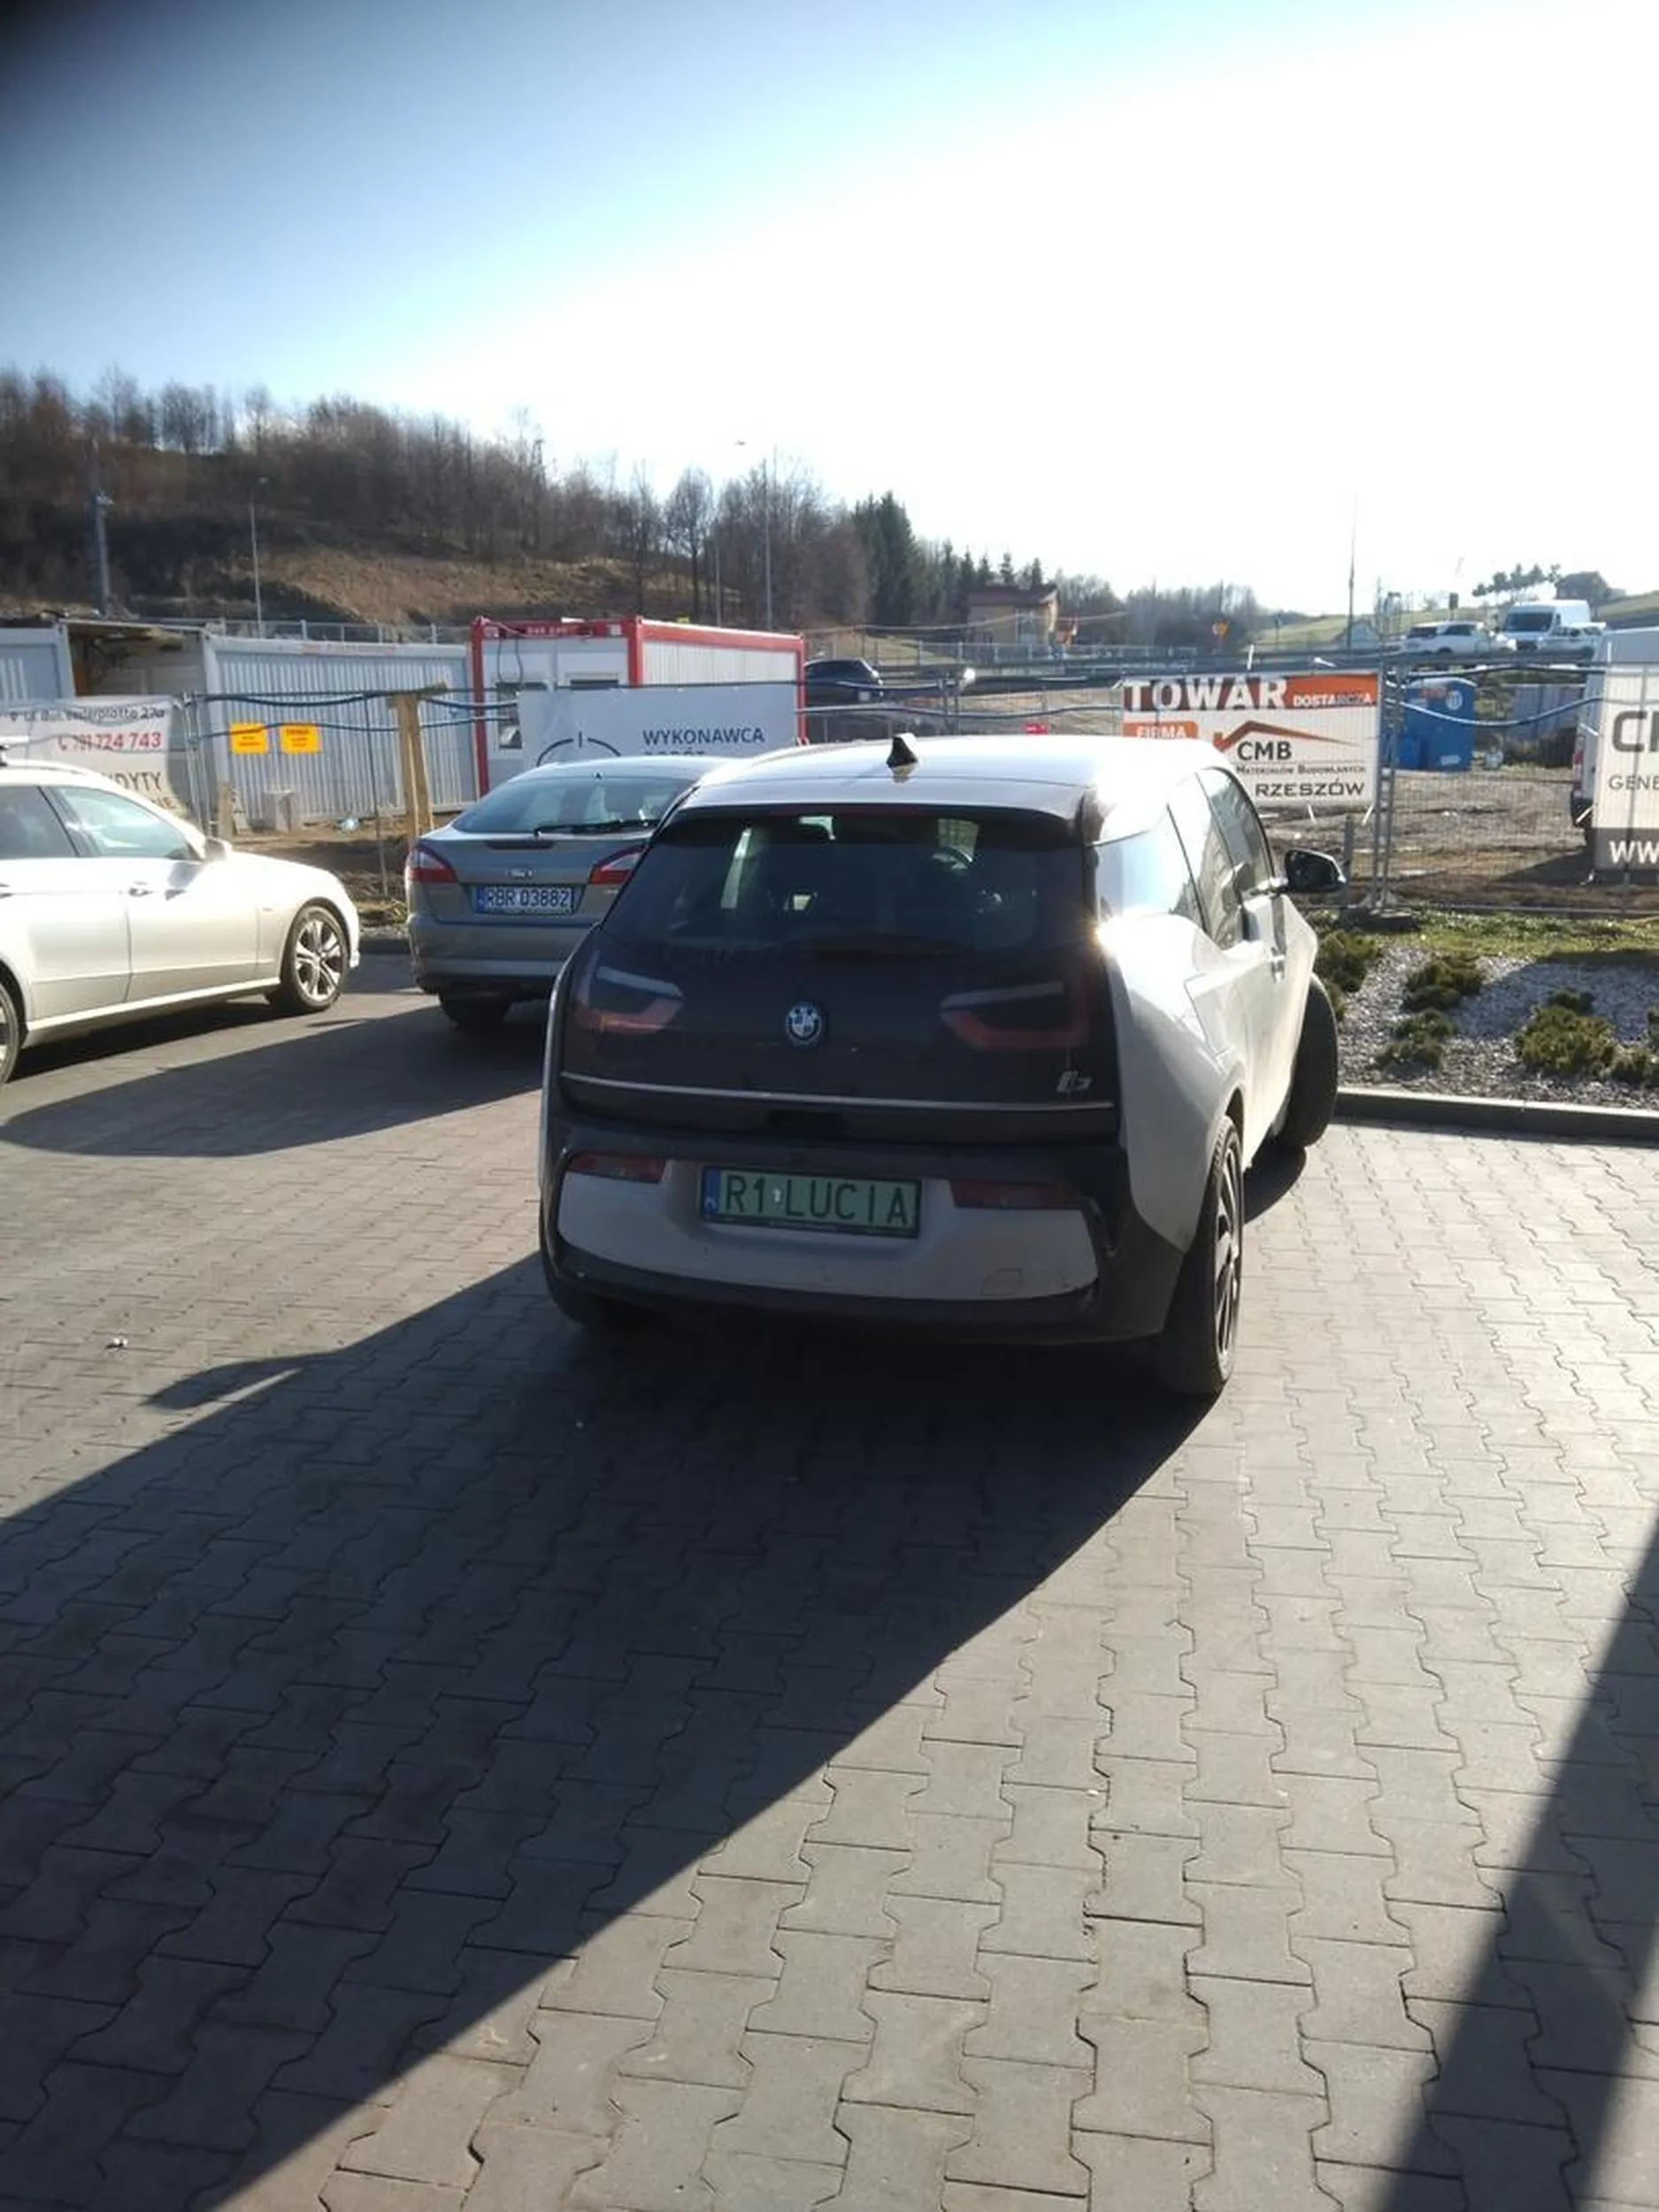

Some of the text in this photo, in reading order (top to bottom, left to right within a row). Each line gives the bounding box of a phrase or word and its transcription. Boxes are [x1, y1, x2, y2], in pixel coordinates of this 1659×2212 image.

[1124, 677, 1287, 710] TOWAR
[130, 733, 162, 749] 743
[642, 727, 765, 746] WYKONAWCA
[1237, 741, 1292, 761] CMB
[1255, 778, 1365, 797] RZESZÓW
[726, 1174, 908, 1225] R1 LUCIA
